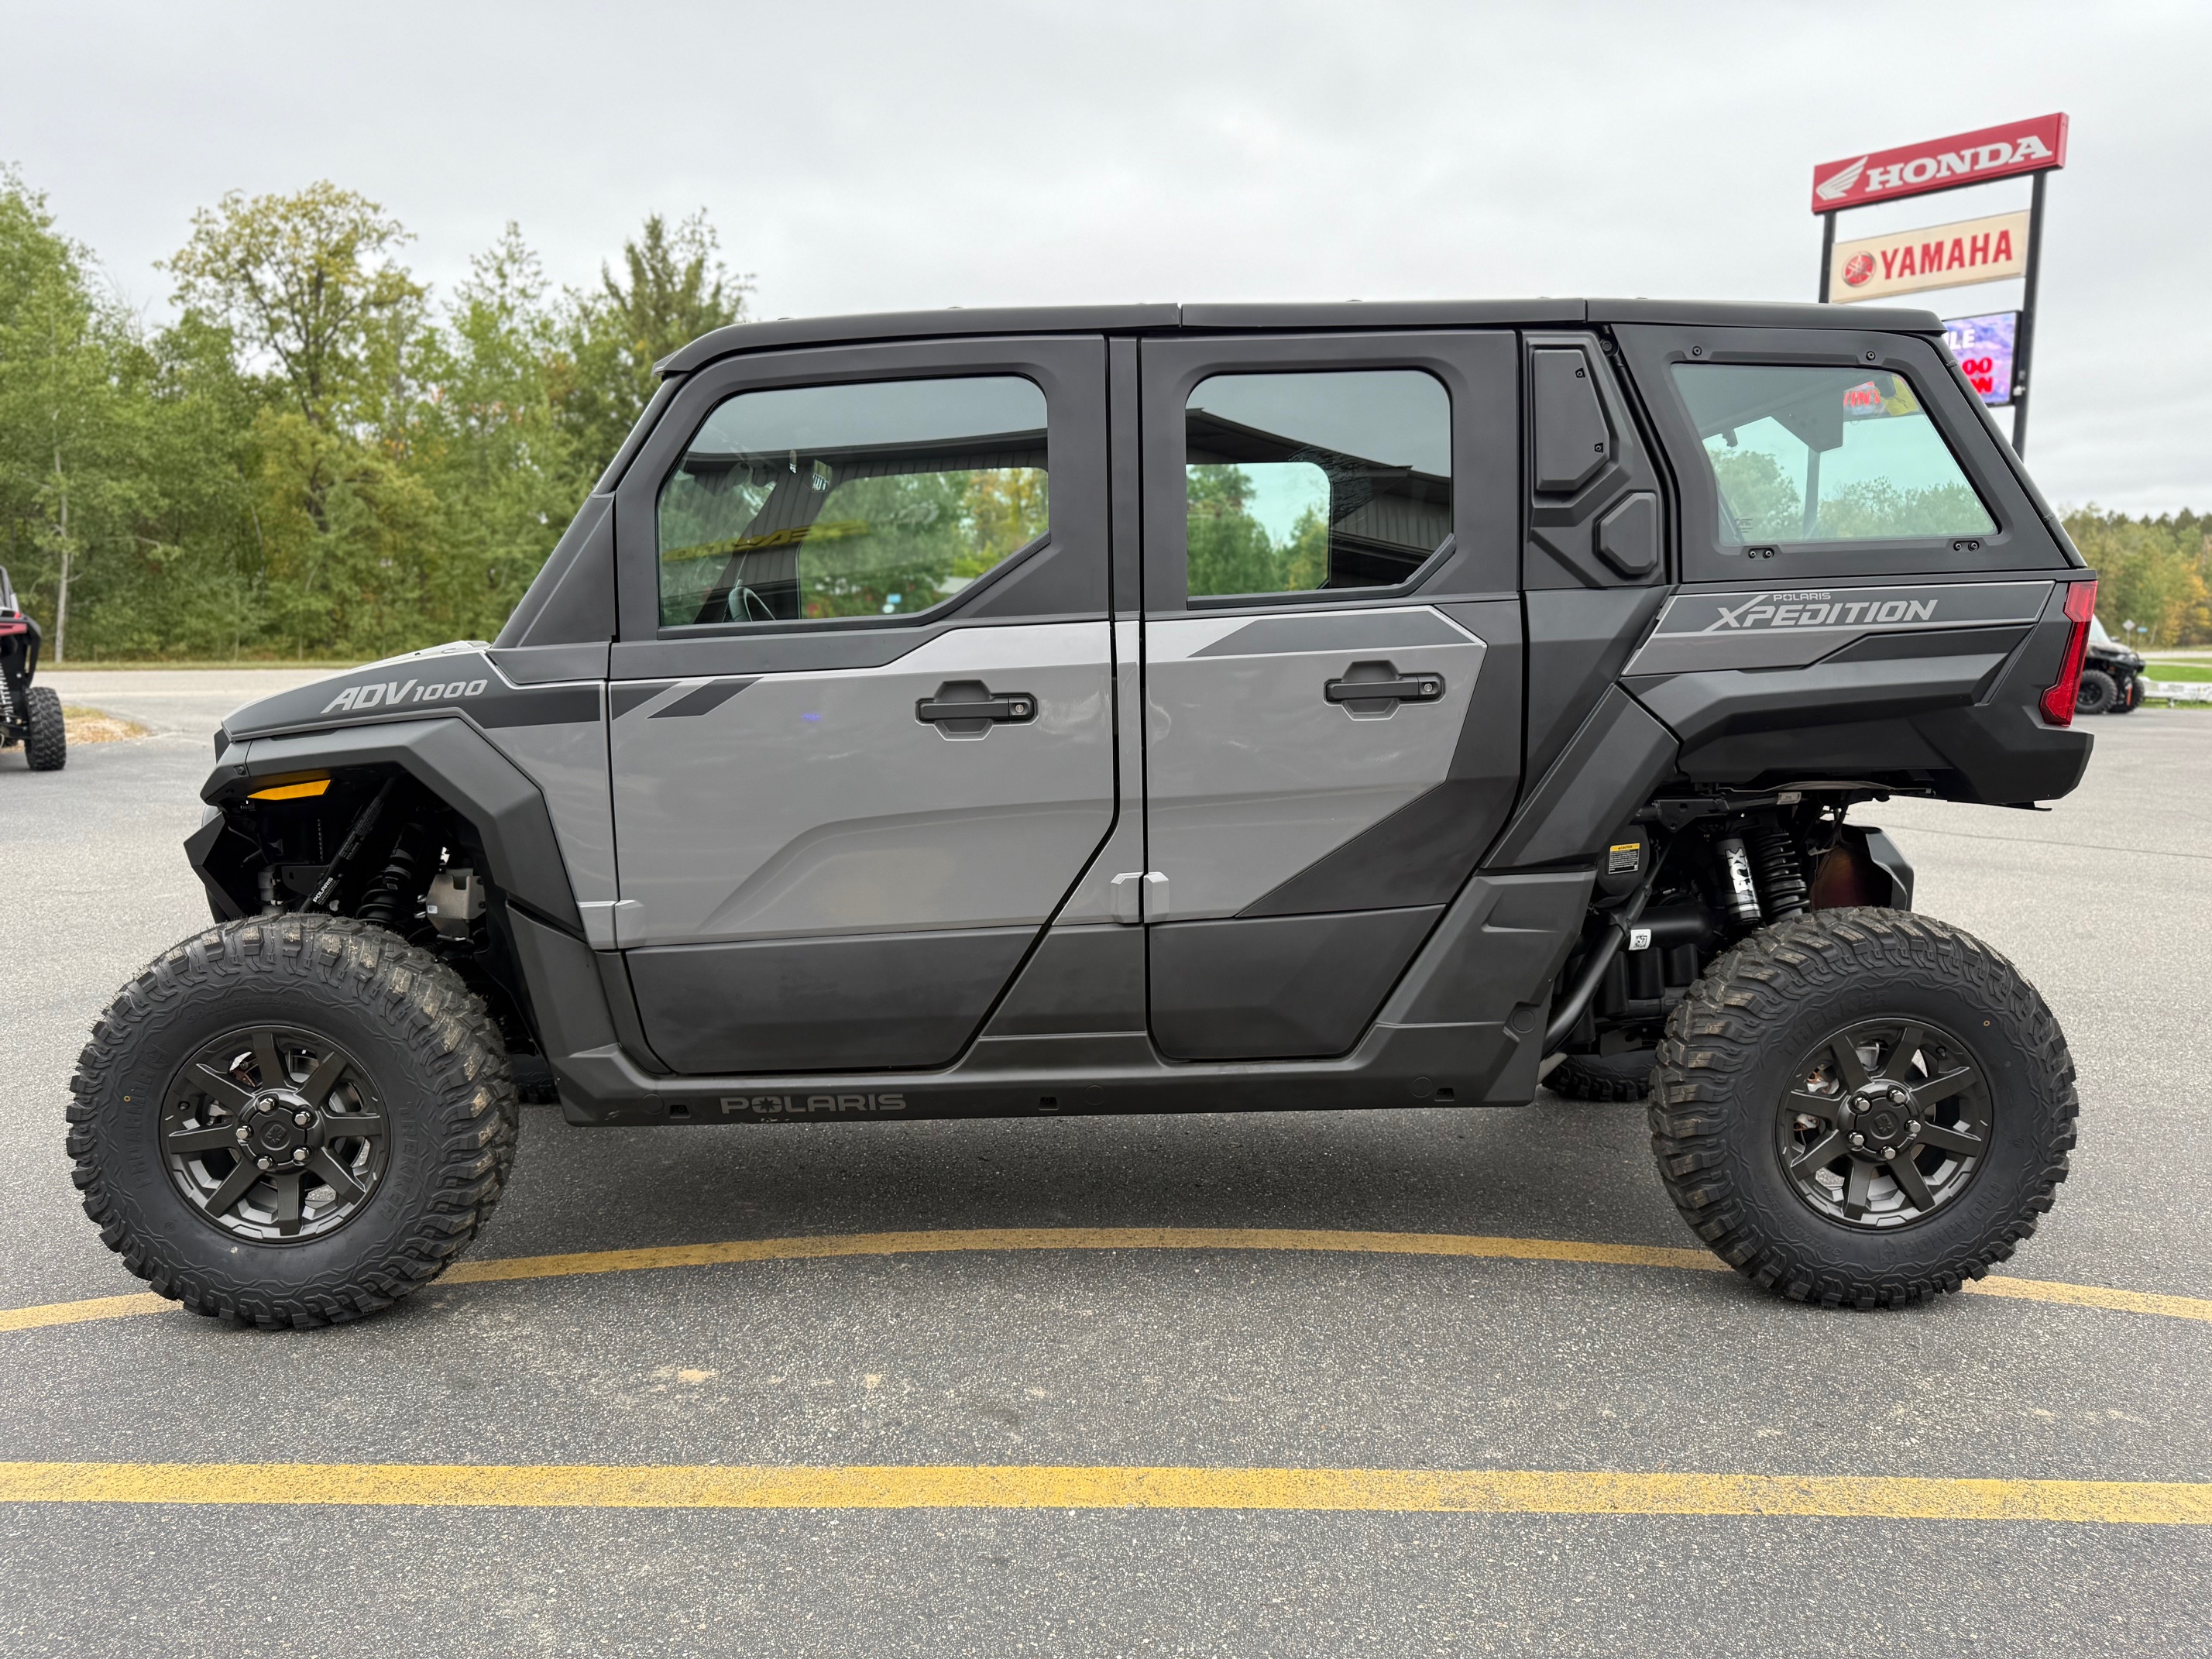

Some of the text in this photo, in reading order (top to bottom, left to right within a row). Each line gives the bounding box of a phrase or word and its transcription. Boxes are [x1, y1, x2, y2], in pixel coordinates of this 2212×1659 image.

[1865, 136, 2052, 192] HONDA
[1881, 229, 2013, 280] YAMAHA
[1707, 595, 1938, 632] XPEDITION
[1773, 592, 1831, 602] POLARIS
[321, 679, 487, 714] ADV 1000
[313, 877, 333, 902] POLARIS
[1725, 847, 1753, 893] FOX
[1778, 990, 1890, 1056] TREKKER
[720, 1092, 906, 1114] POLARIS
[124, 1068, 156, 1189] PROARMOR
[380, 1102, 418, 1221] TREKKER
[1901, 1181, 2005, 1259] PROARMOR
